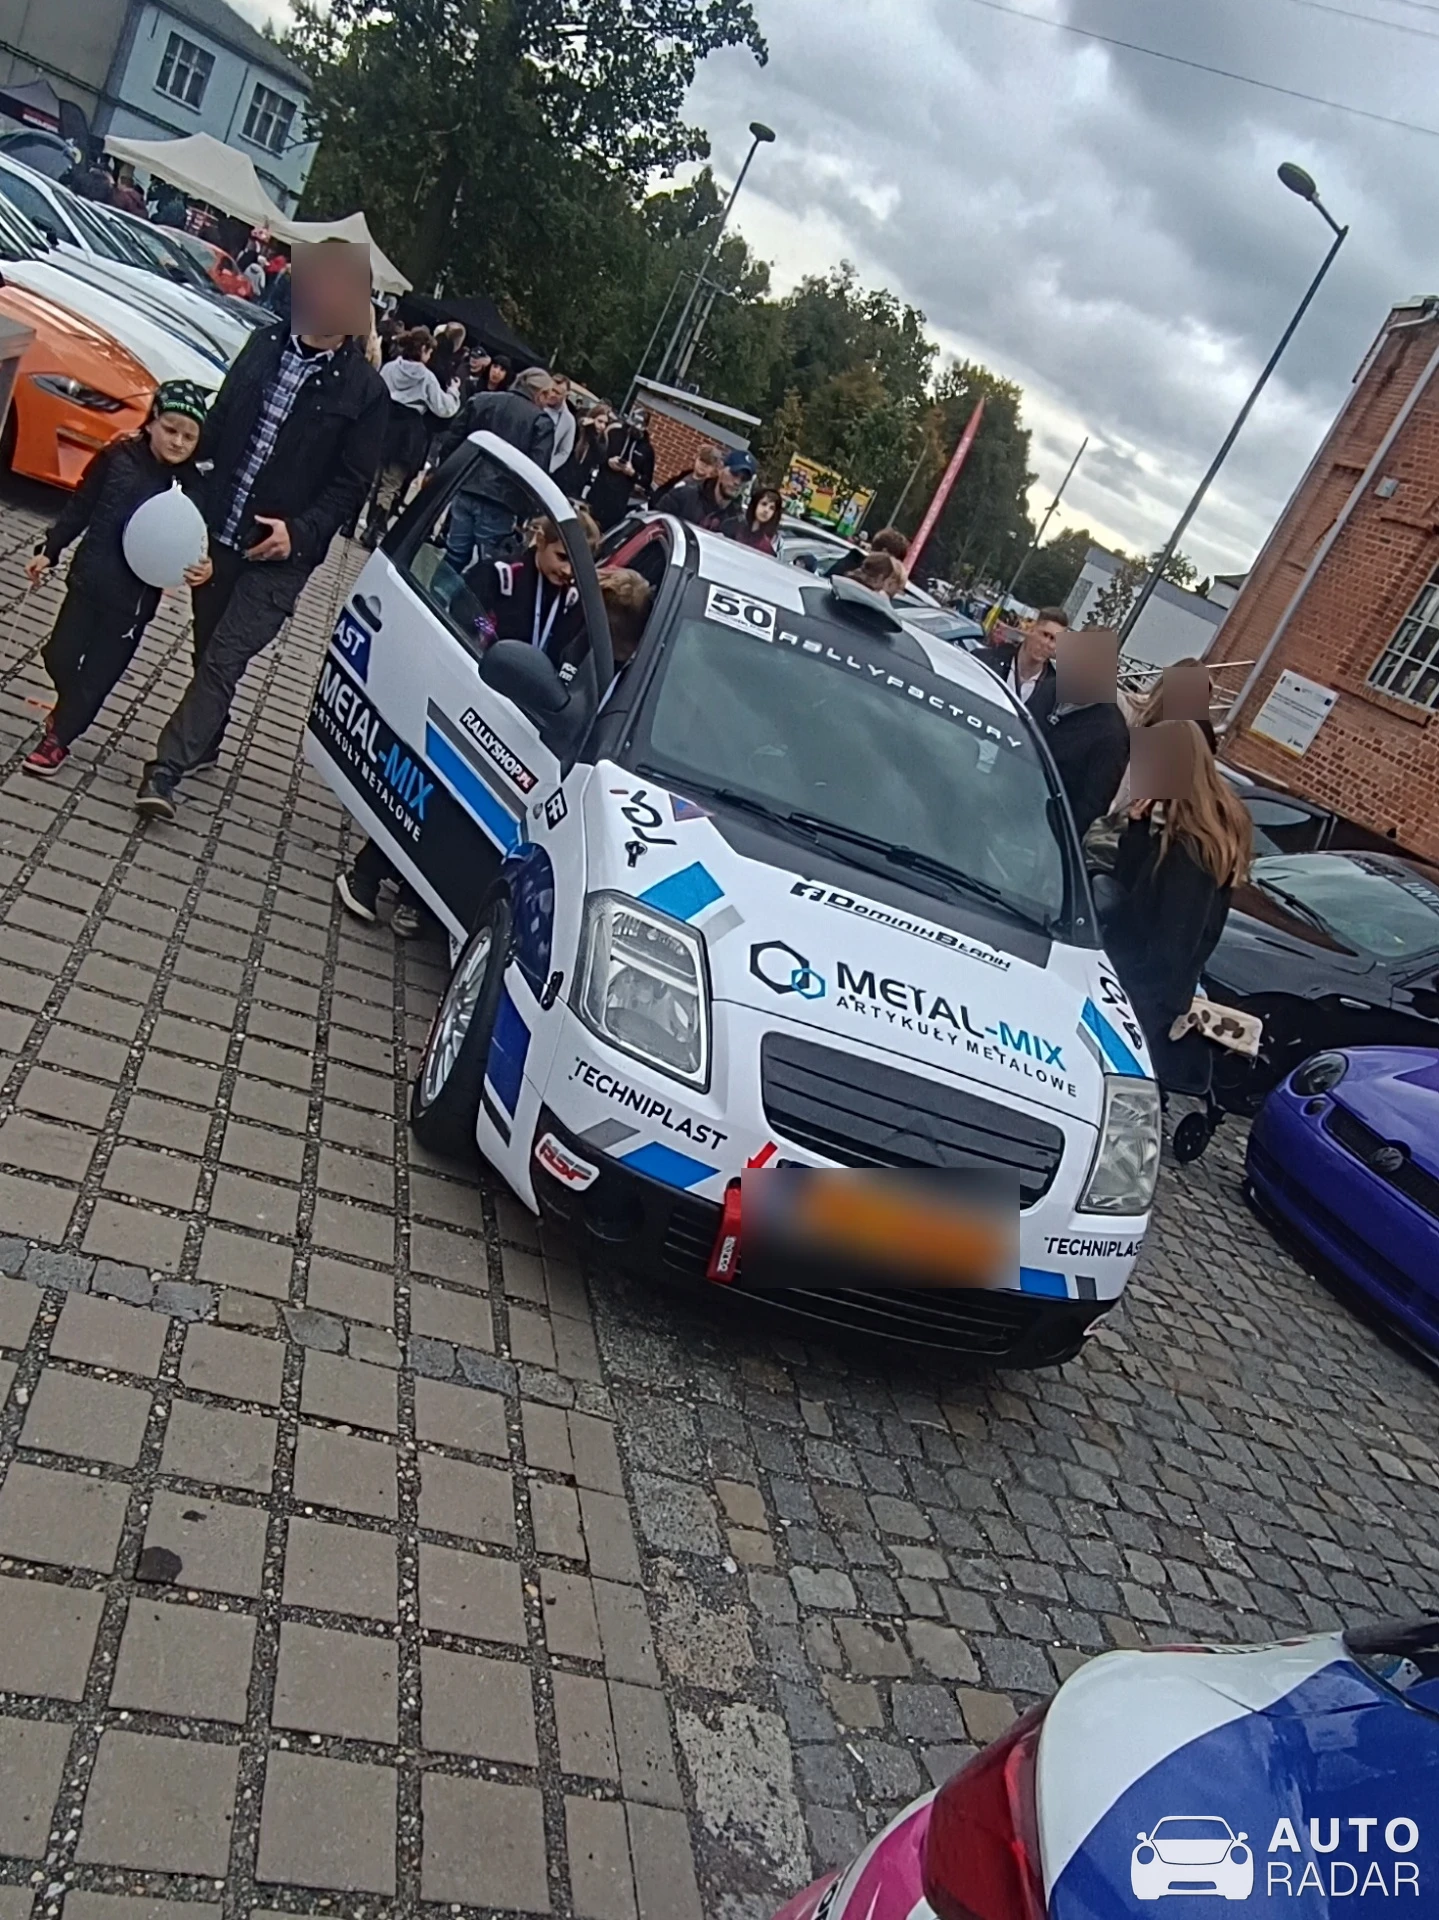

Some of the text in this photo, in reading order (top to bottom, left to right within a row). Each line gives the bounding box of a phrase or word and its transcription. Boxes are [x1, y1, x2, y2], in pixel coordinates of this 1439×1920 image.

[711, 593, 772, 628] 50
[778, 631, 1021, 748] RALLYFACTORY
[318, 661, 433, 820] METAL-MIX
[462, 710, 533, 788] RALLYSHOP.PL
[361, 764, 421, 842] METALOWE
[836, 960, 1067, 1071] METAL-MIX
[836, 997, 1077, 1098] ARTYKUŁY METALOWE
[567, 1056, 728, 1150] TECHNIPLAST
[1044, 1236, 1143, 1257] TECHNIPLAS
